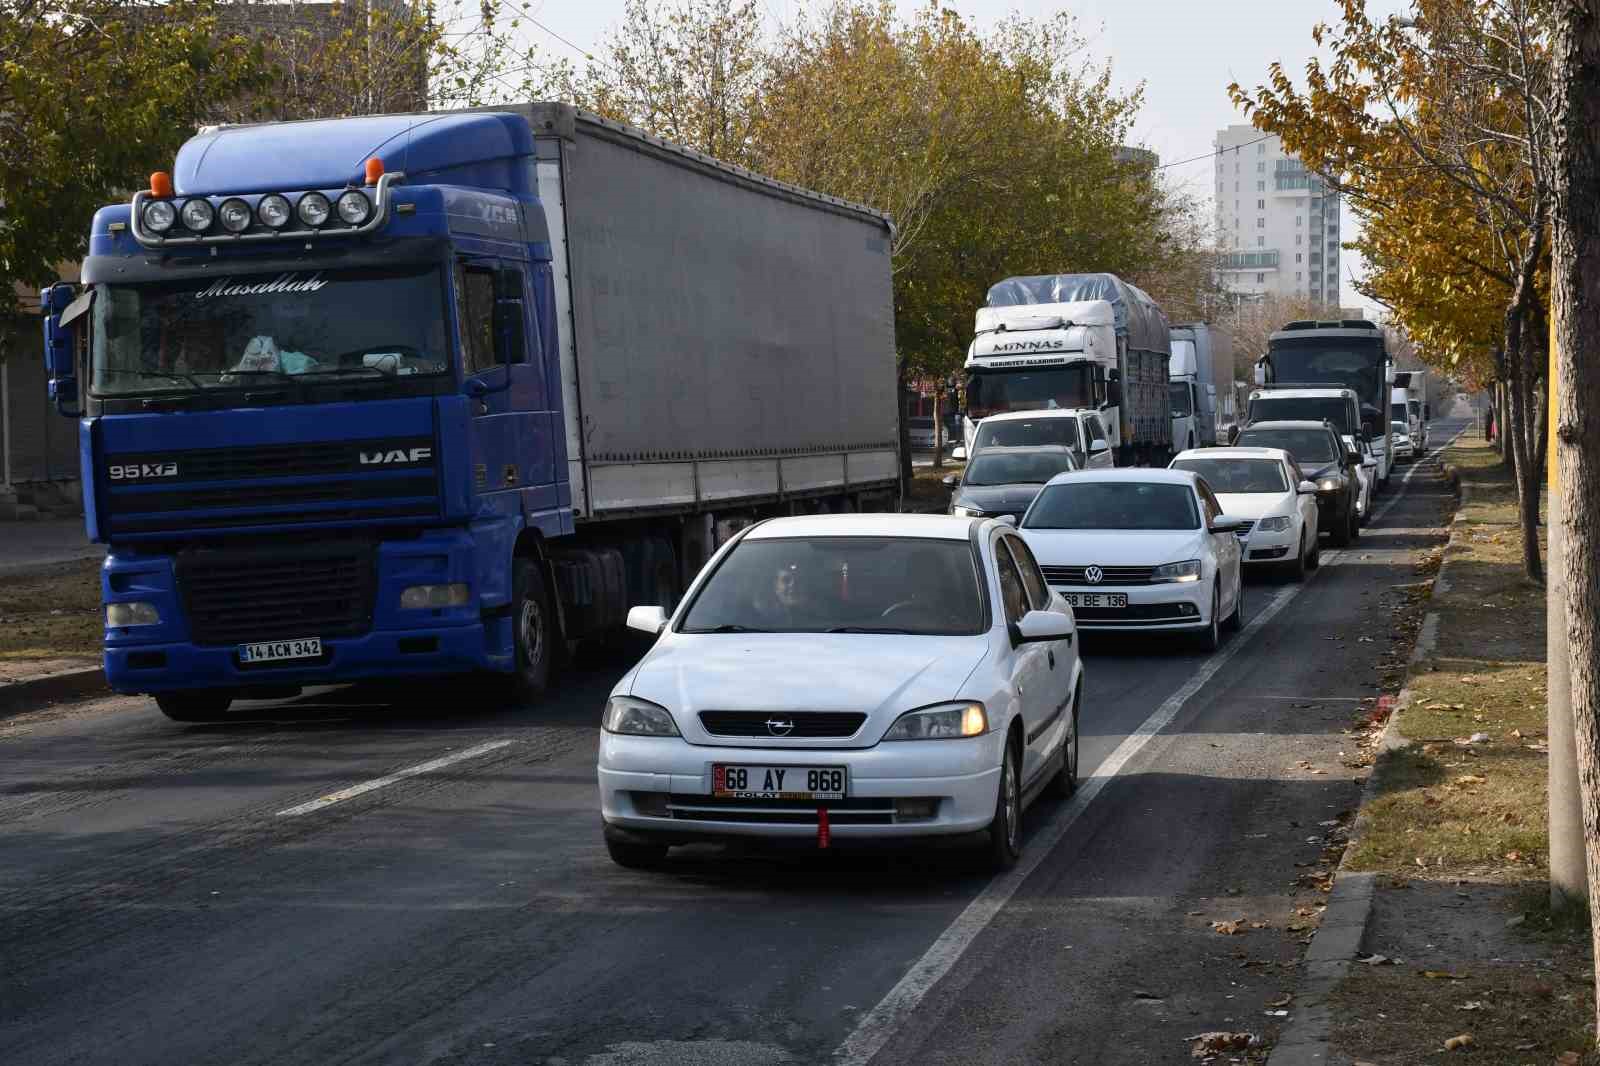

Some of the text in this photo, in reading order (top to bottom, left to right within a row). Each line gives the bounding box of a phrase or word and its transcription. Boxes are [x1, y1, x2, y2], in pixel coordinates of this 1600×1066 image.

[360, 448, 431, 464] DAF
[1107, 596, 1125, 607] 136
[248, 641, 320, 659] 14 ACN 342
[726, 768, 748, 790] 68
[763, 769, 786, 791] AY
[807, 770, 842, 792] 868
